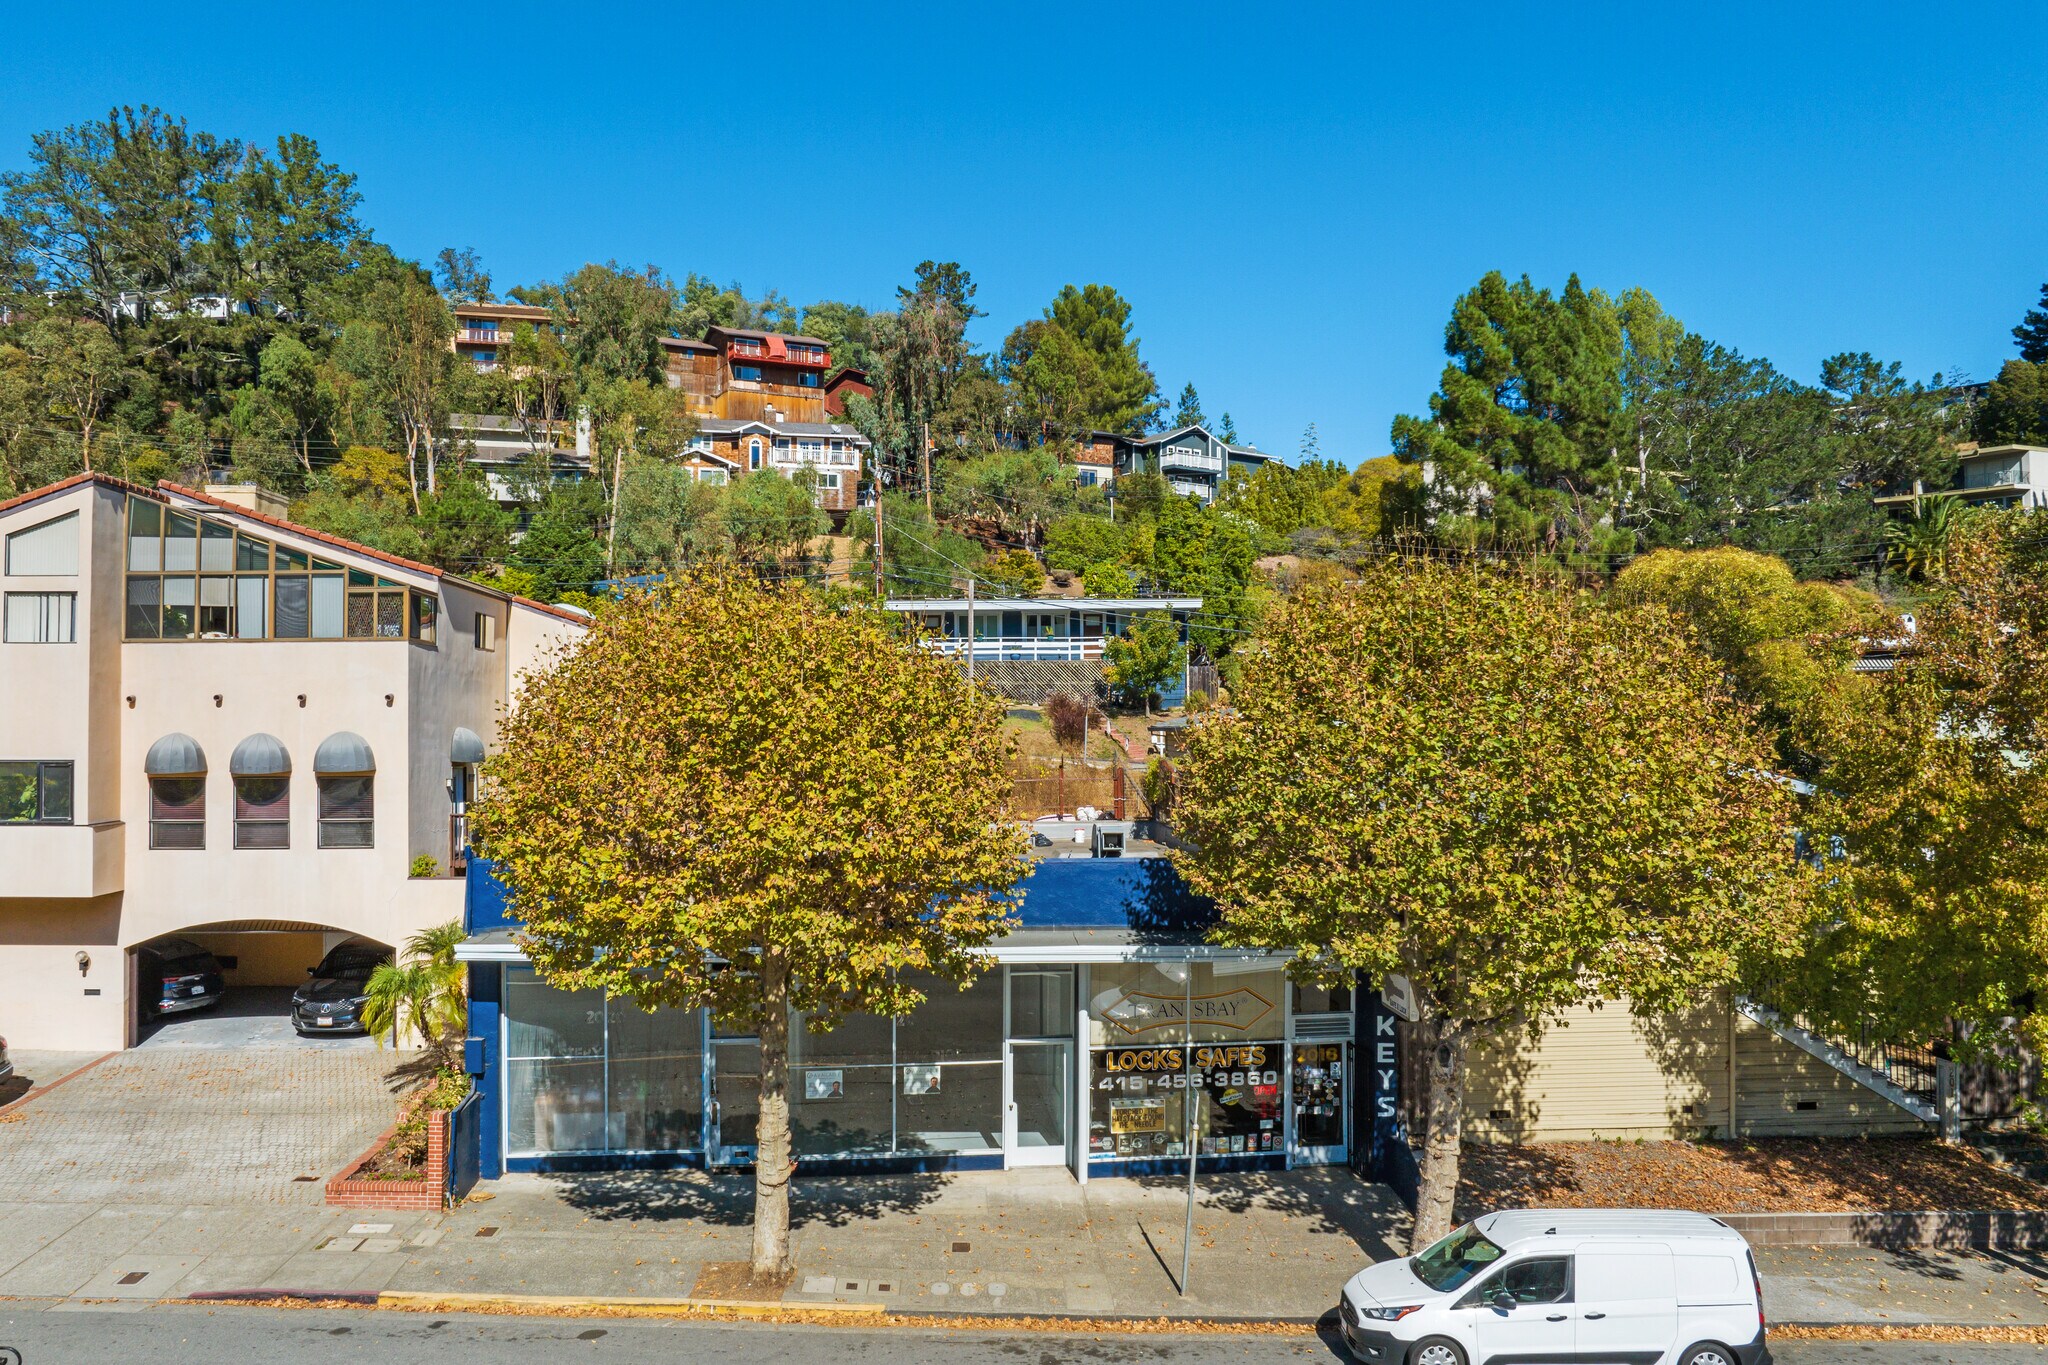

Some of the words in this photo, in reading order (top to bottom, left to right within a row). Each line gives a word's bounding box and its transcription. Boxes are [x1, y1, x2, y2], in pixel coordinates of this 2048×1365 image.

[1106, 1049, 1182, 1073] LOCKS
[1196, 1046, 1266, 1069] SAFES
[1376, 1015, 1395, 1118] KEYS
[1253, 1085, 1277, 1096] OPEN
